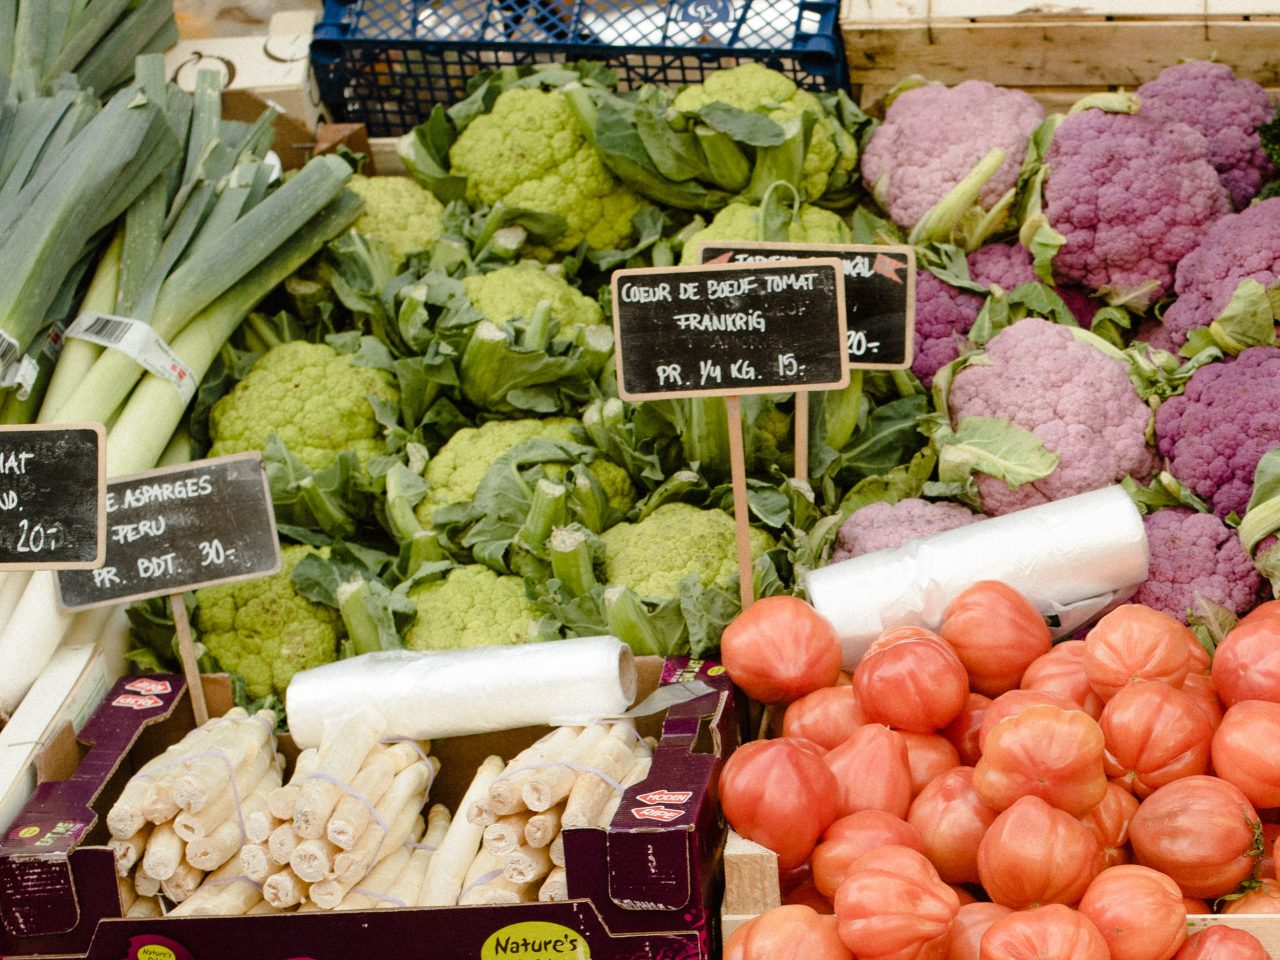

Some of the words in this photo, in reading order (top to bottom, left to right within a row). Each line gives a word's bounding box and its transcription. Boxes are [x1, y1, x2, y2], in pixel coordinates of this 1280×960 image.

[679, 281, 700, 301] DE
[763, 272, 819, 294] TOMAT
[656, 365, 692, 386] PR.
[730, 358, 763, 381] KG.
[0, 451, 35, 475] AT
[123, 475, 213, 509] ASPARGES
[111, 516, 166, 545] PERU
[92, 567, 127, 589] PR.
[137, 552, 182, 579] BDT.
[142, 947, 173, 959] Nature's
[494, 934, 579, 956] Nature's
